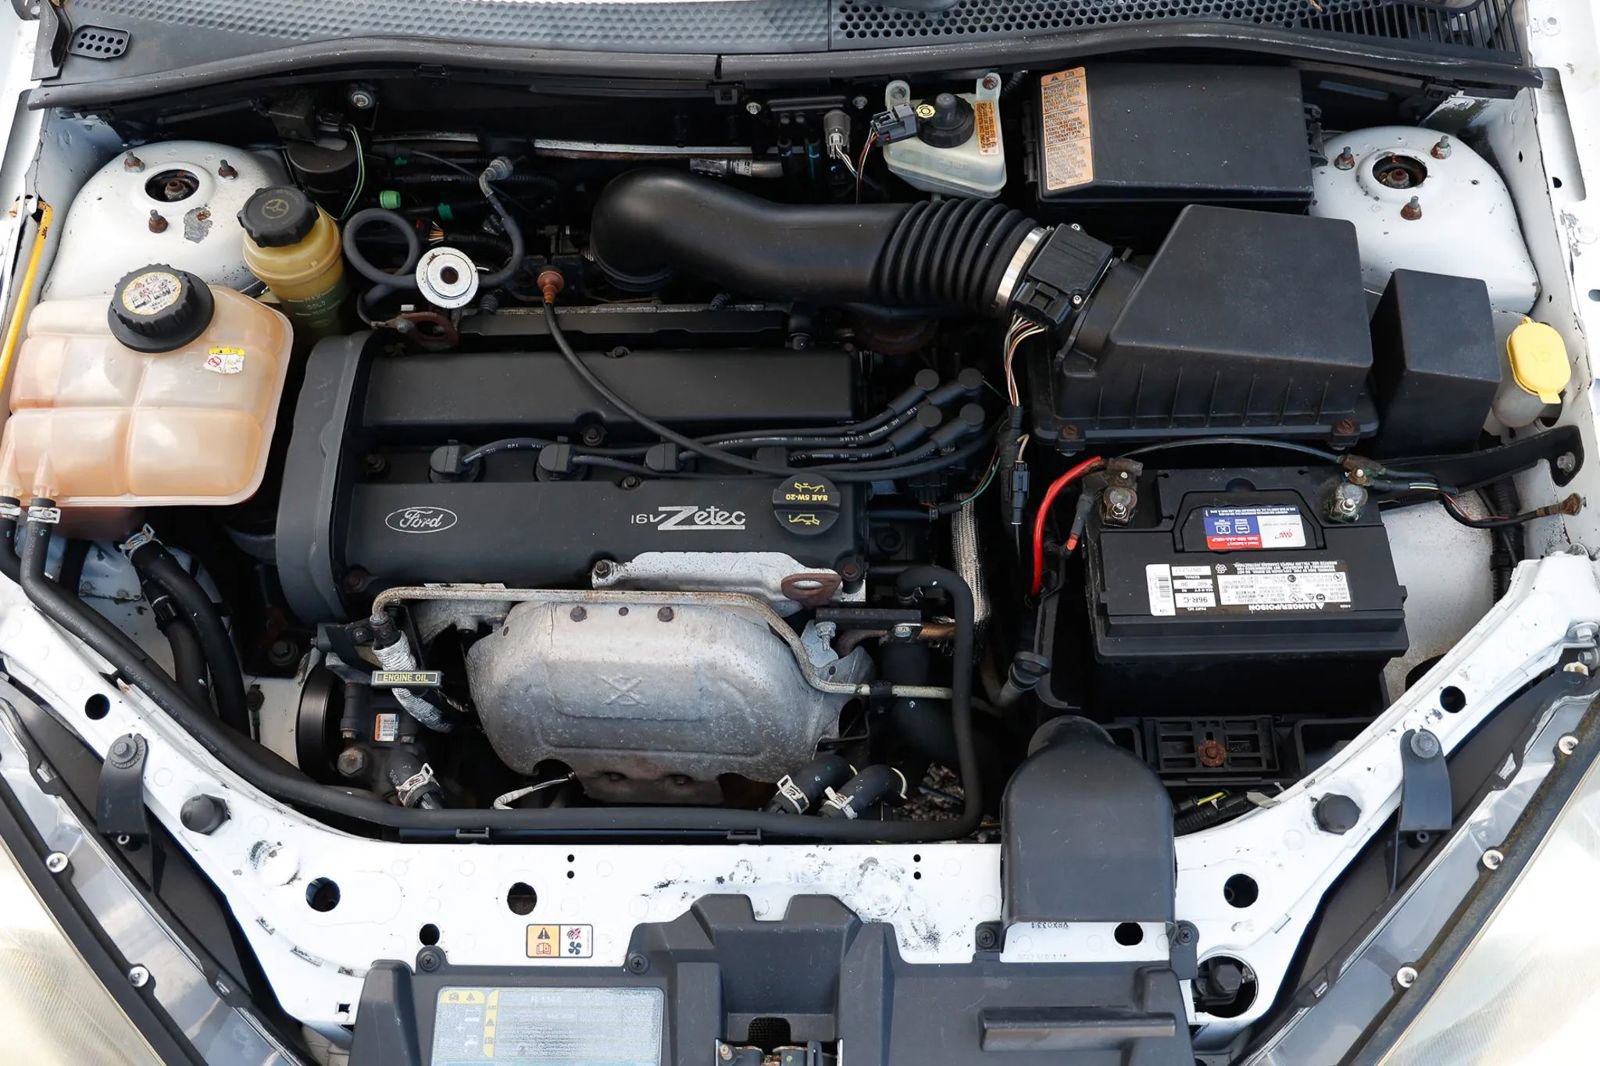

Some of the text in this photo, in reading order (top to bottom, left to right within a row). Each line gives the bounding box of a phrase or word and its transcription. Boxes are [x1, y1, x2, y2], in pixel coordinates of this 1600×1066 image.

[785, 493, 810, 502] 5W-20
[399, 509, 444, 528] Ford
[657, 505, 746, 531] Zetec
[383, 673, 429, 682] ENGINE OIL
